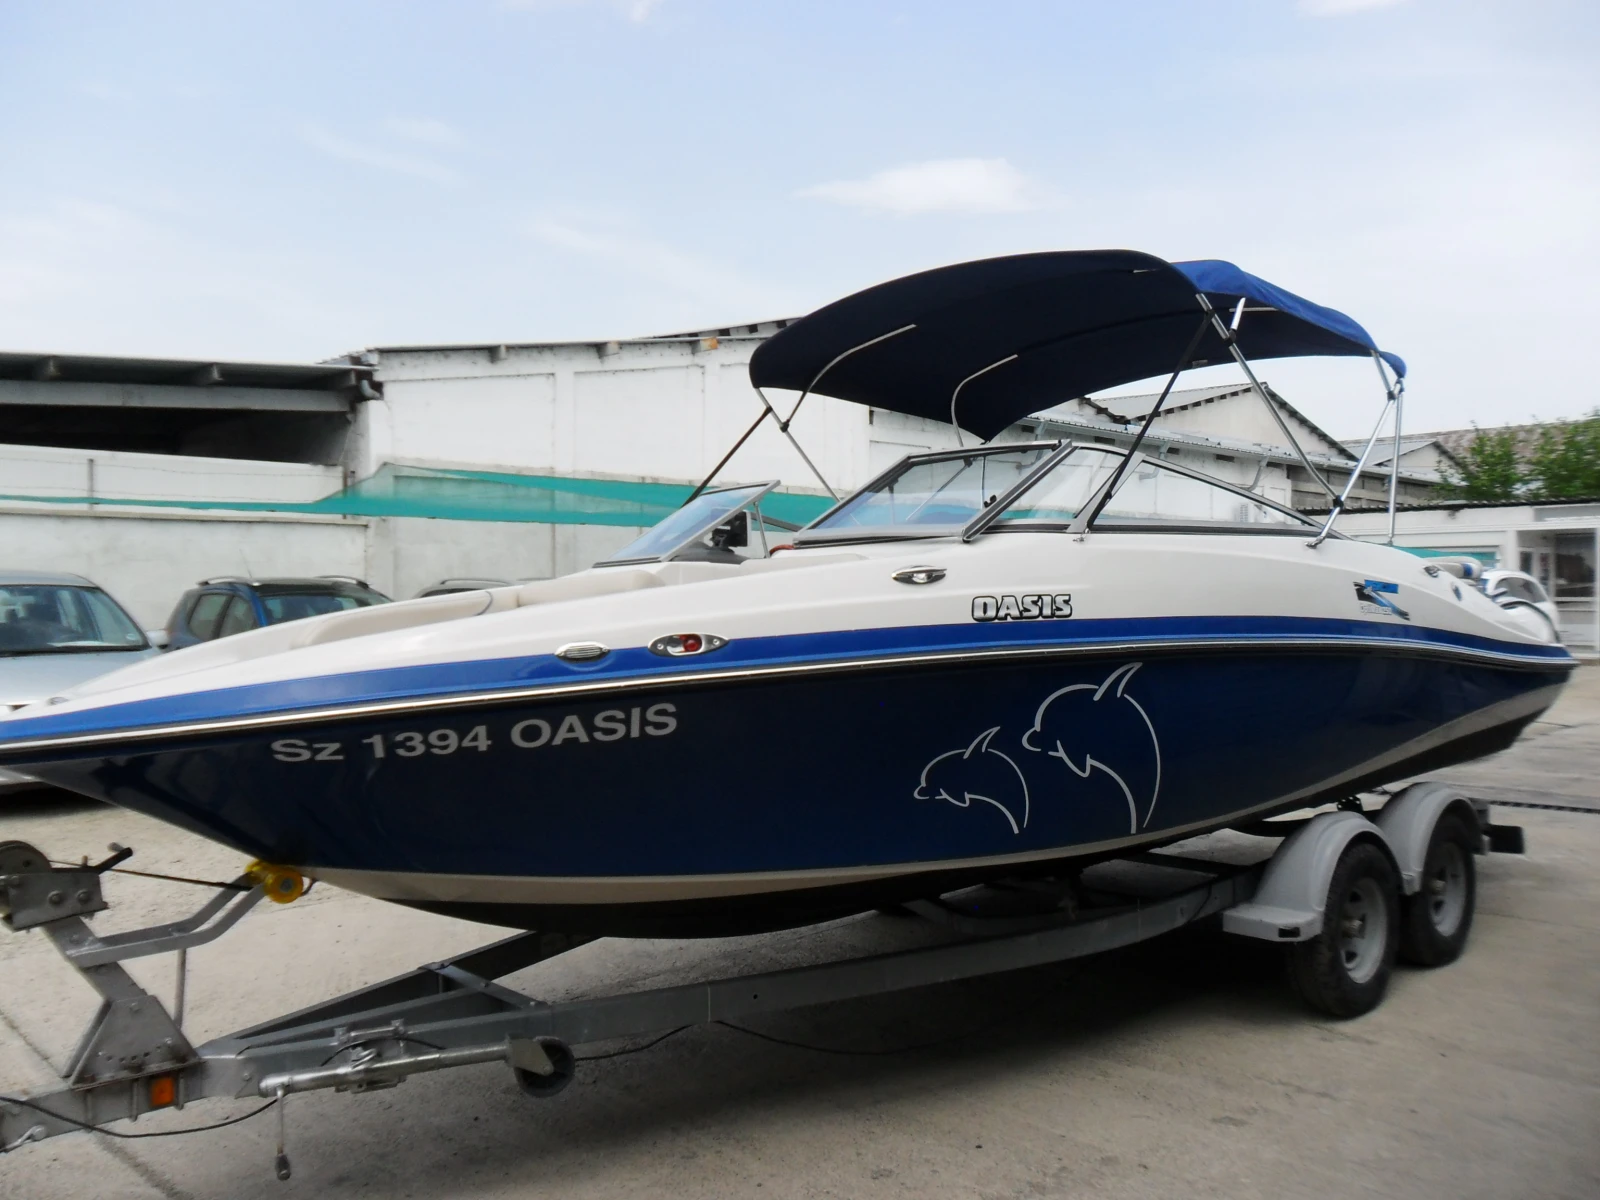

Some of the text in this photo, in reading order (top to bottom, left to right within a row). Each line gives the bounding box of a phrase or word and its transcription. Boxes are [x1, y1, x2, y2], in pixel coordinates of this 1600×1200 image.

[971, 593, 1073, 622] OASIS
[270, 702, 679, 763] Sz 1394 OASIS
